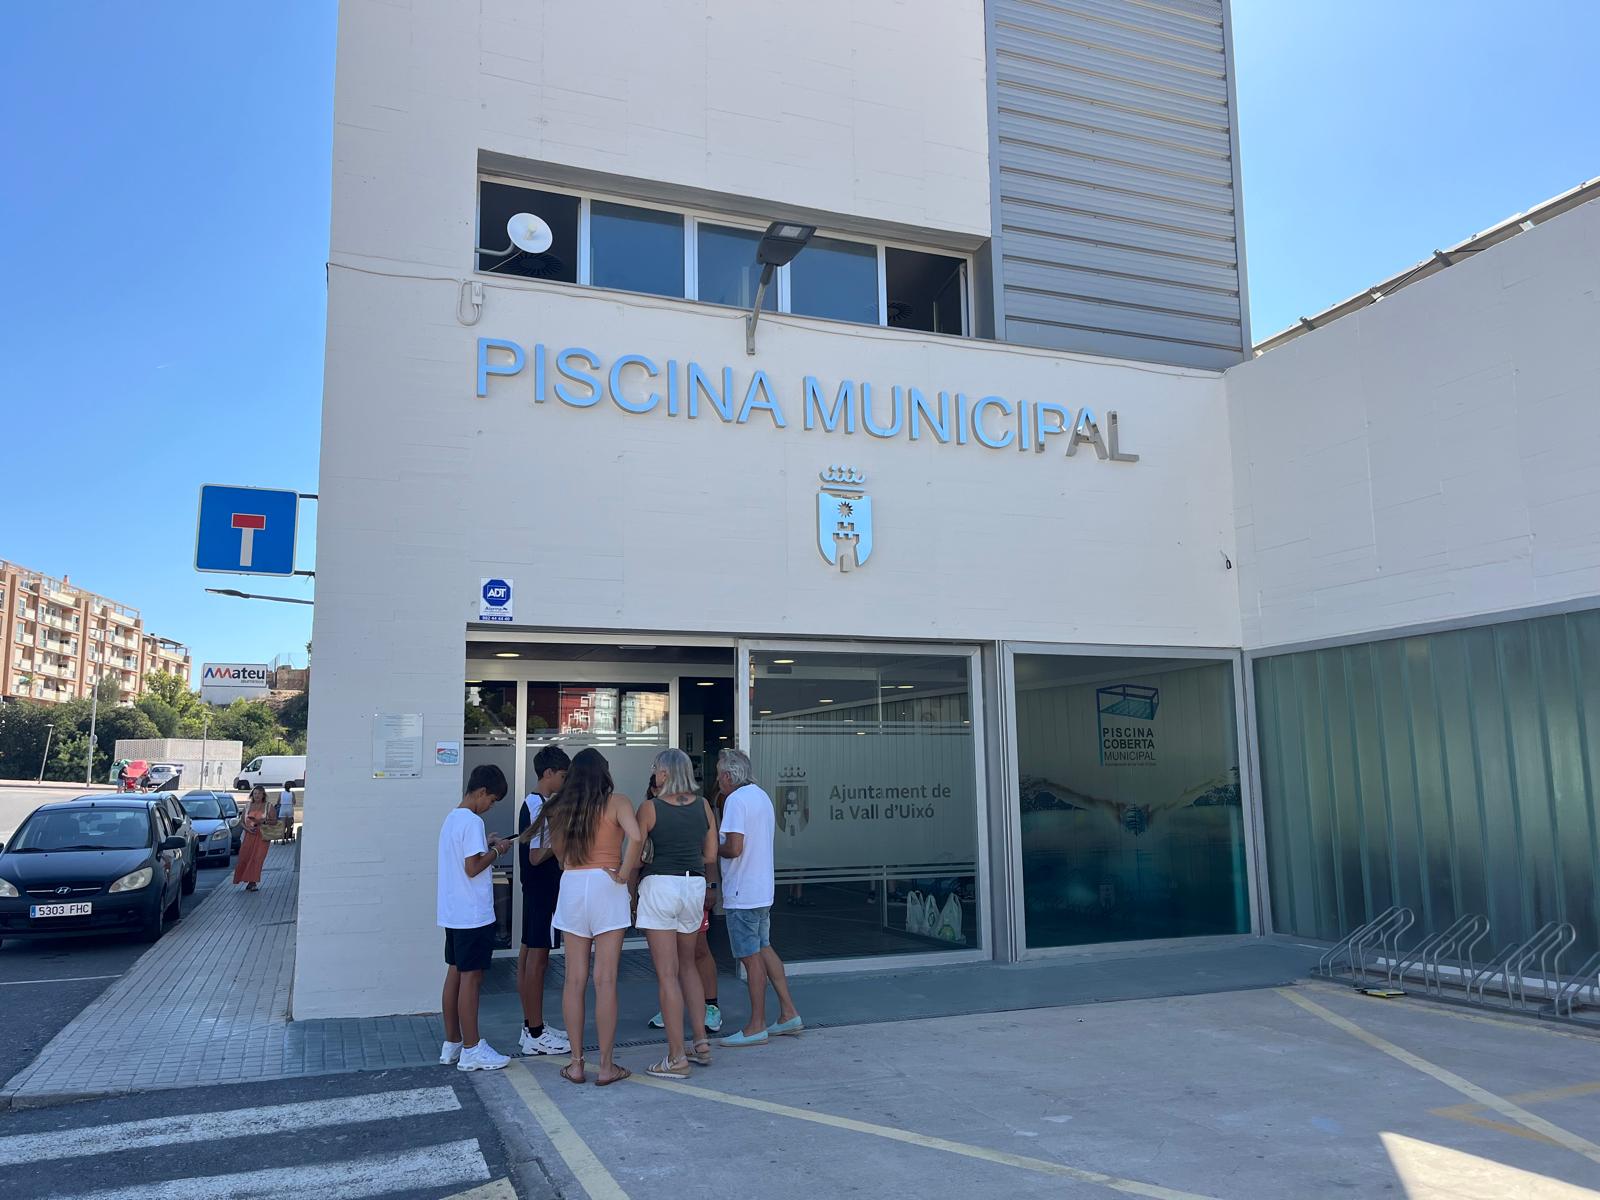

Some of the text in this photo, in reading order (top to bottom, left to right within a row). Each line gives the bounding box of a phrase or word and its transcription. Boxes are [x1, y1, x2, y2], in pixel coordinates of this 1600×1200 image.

[476, 336, 1140, 462] PISCINA MUNICIPAL
[488, 588, 506, 598] ADT
[1102, 727, 1154, 738] PISCINA
[1103, 739, 1155, 750] COBERTA
[1104, 751, 1157, 761] MUNICIPAL
[829, 783, 951, 803] Ajuntament de
[829, 804, 844, 821] la
[849, 803, 879, 820] Vall
[38, 904, 89, 916] 5303 FHC
